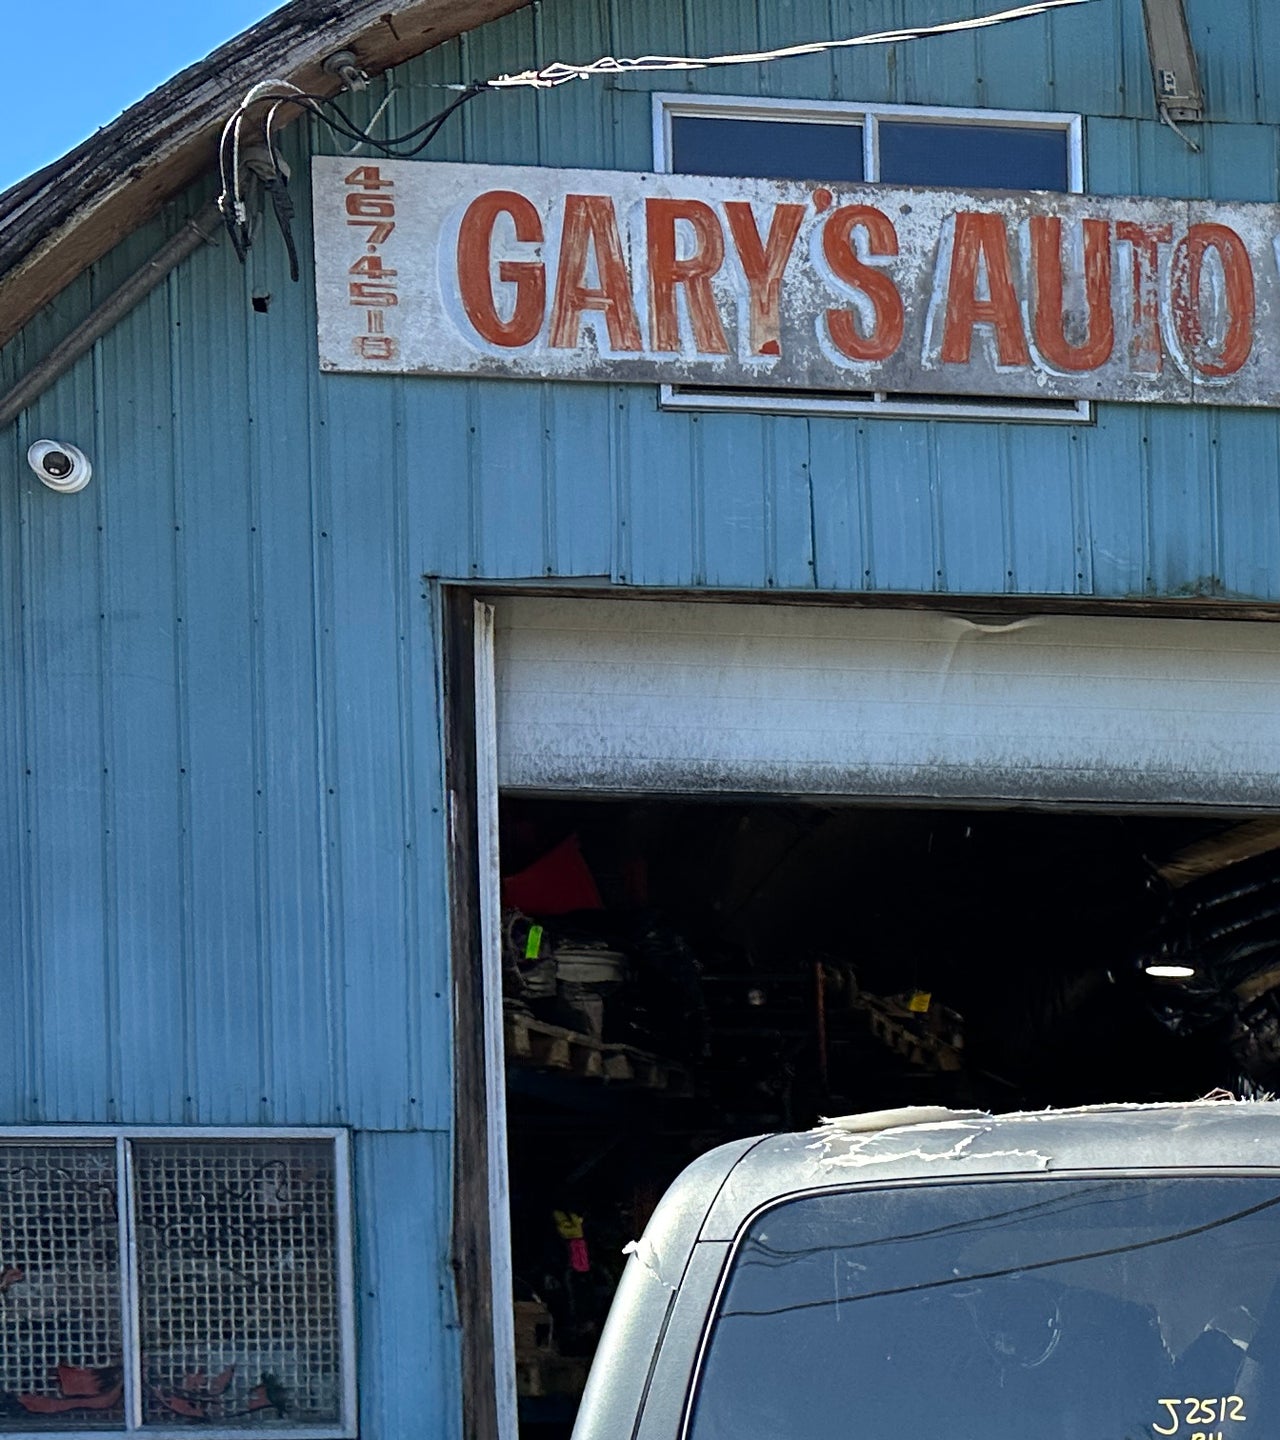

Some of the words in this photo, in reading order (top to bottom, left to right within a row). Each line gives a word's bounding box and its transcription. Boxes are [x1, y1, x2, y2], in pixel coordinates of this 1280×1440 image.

[456, 187, 905, 364] GARY'S
[940, 208, 1256, 379] AUTO
[1152, 1395, 1247, 1436] J2512
